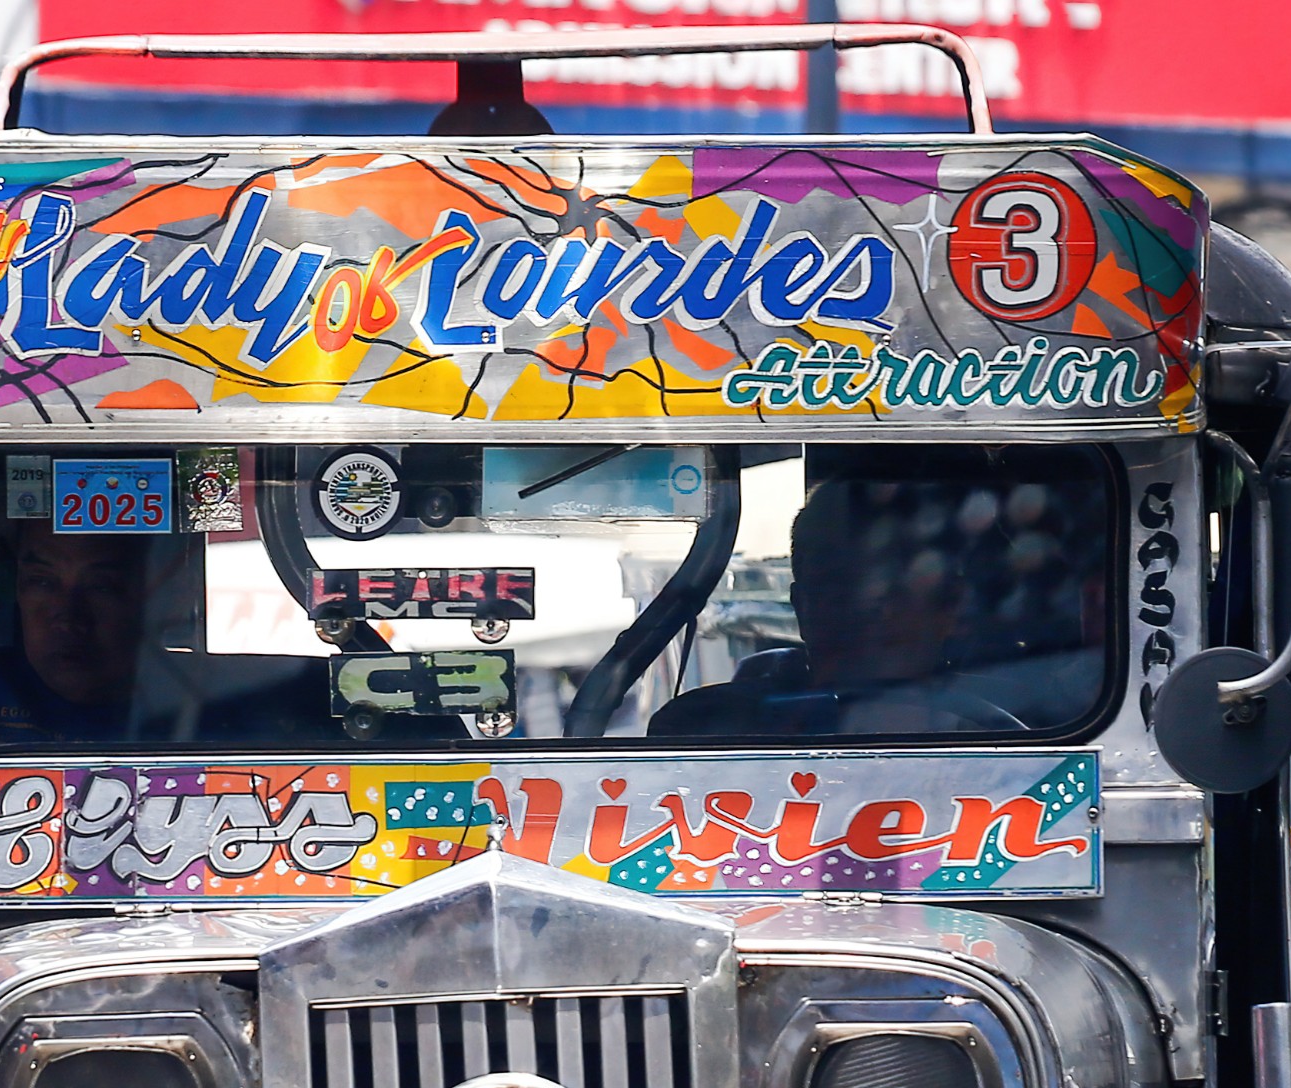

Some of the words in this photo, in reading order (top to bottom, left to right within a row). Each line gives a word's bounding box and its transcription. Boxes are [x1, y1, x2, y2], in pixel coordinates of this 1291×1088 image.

[409, 194, 898, 351] Lourdes
[976, 184, 1066, 310] 3
[723, 336, 1164, 409] Attraction
[12, 470, 44, 480] 2019
[62, 493, 163, 526] 2025
